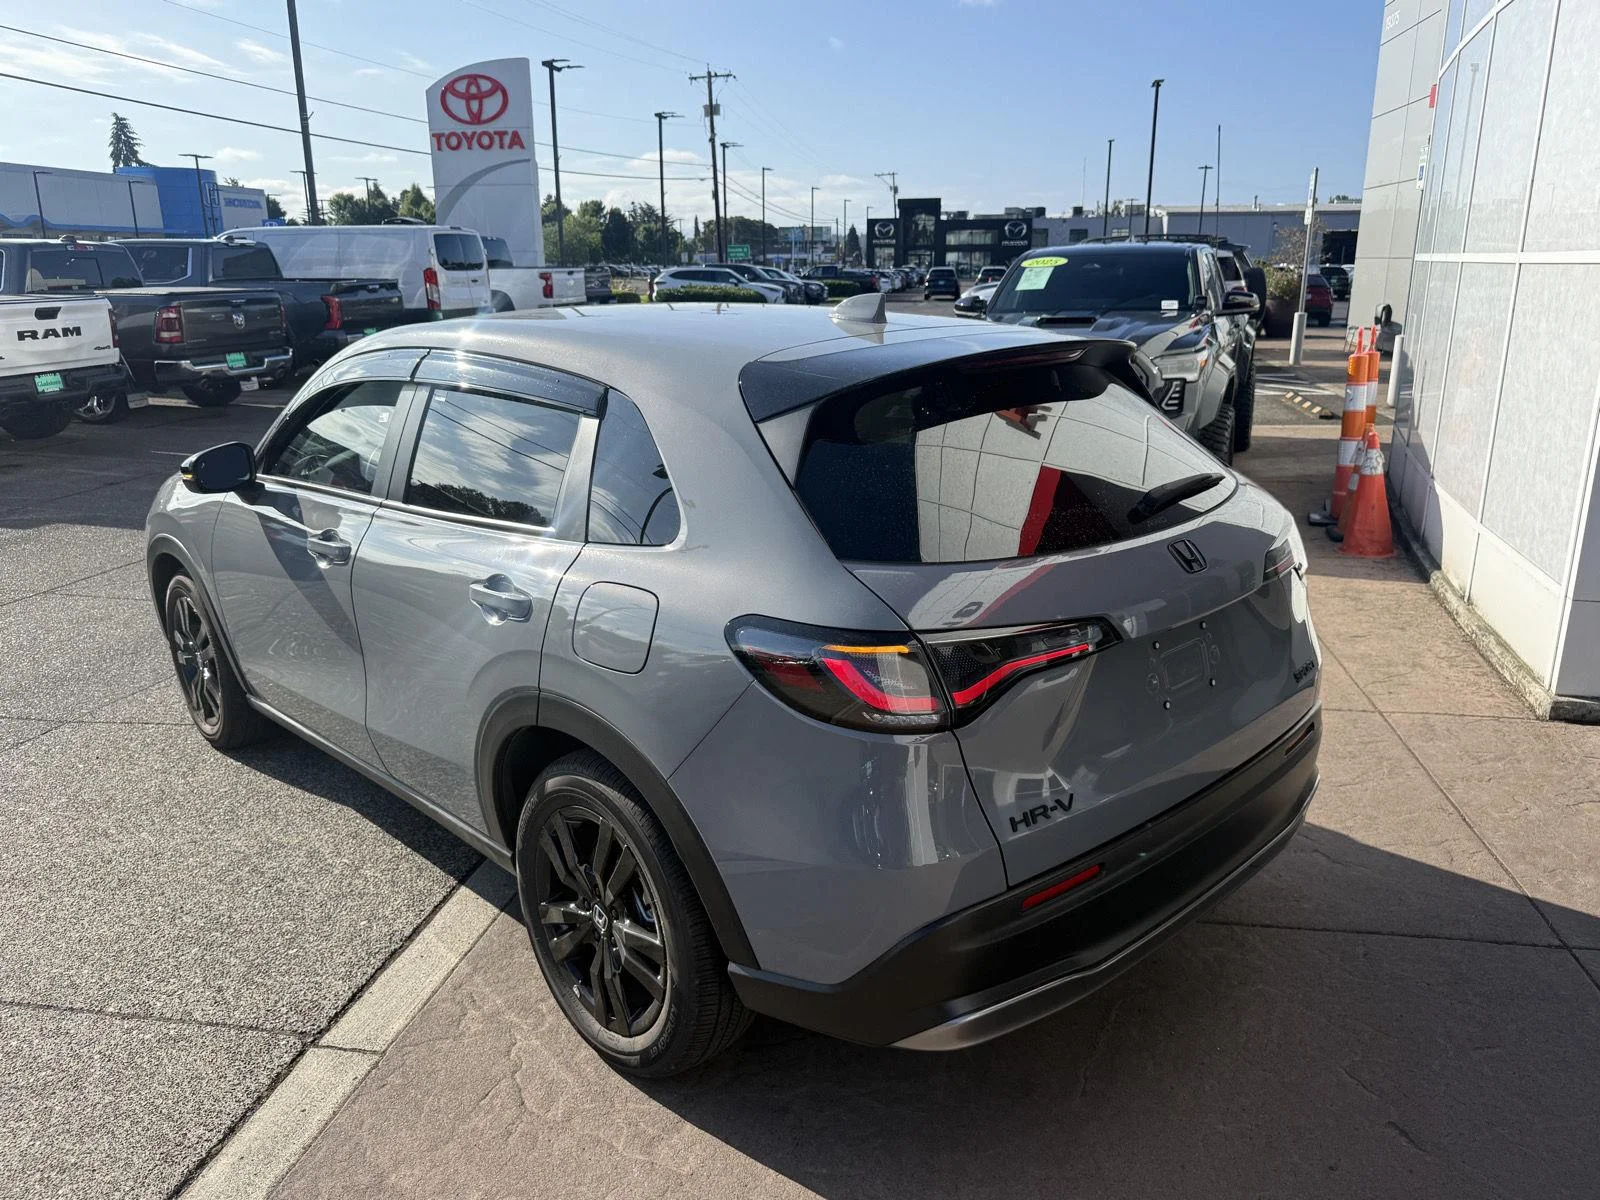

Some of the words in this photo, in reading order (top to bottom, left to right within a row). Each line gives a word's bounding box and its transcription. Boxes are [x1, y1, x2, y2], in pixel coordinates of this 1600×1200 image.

[432, 130, 525, 151] TOYOTA
[17, 326, 82, 341] RAM
[1009, 793, 1074, 833] HR-V
